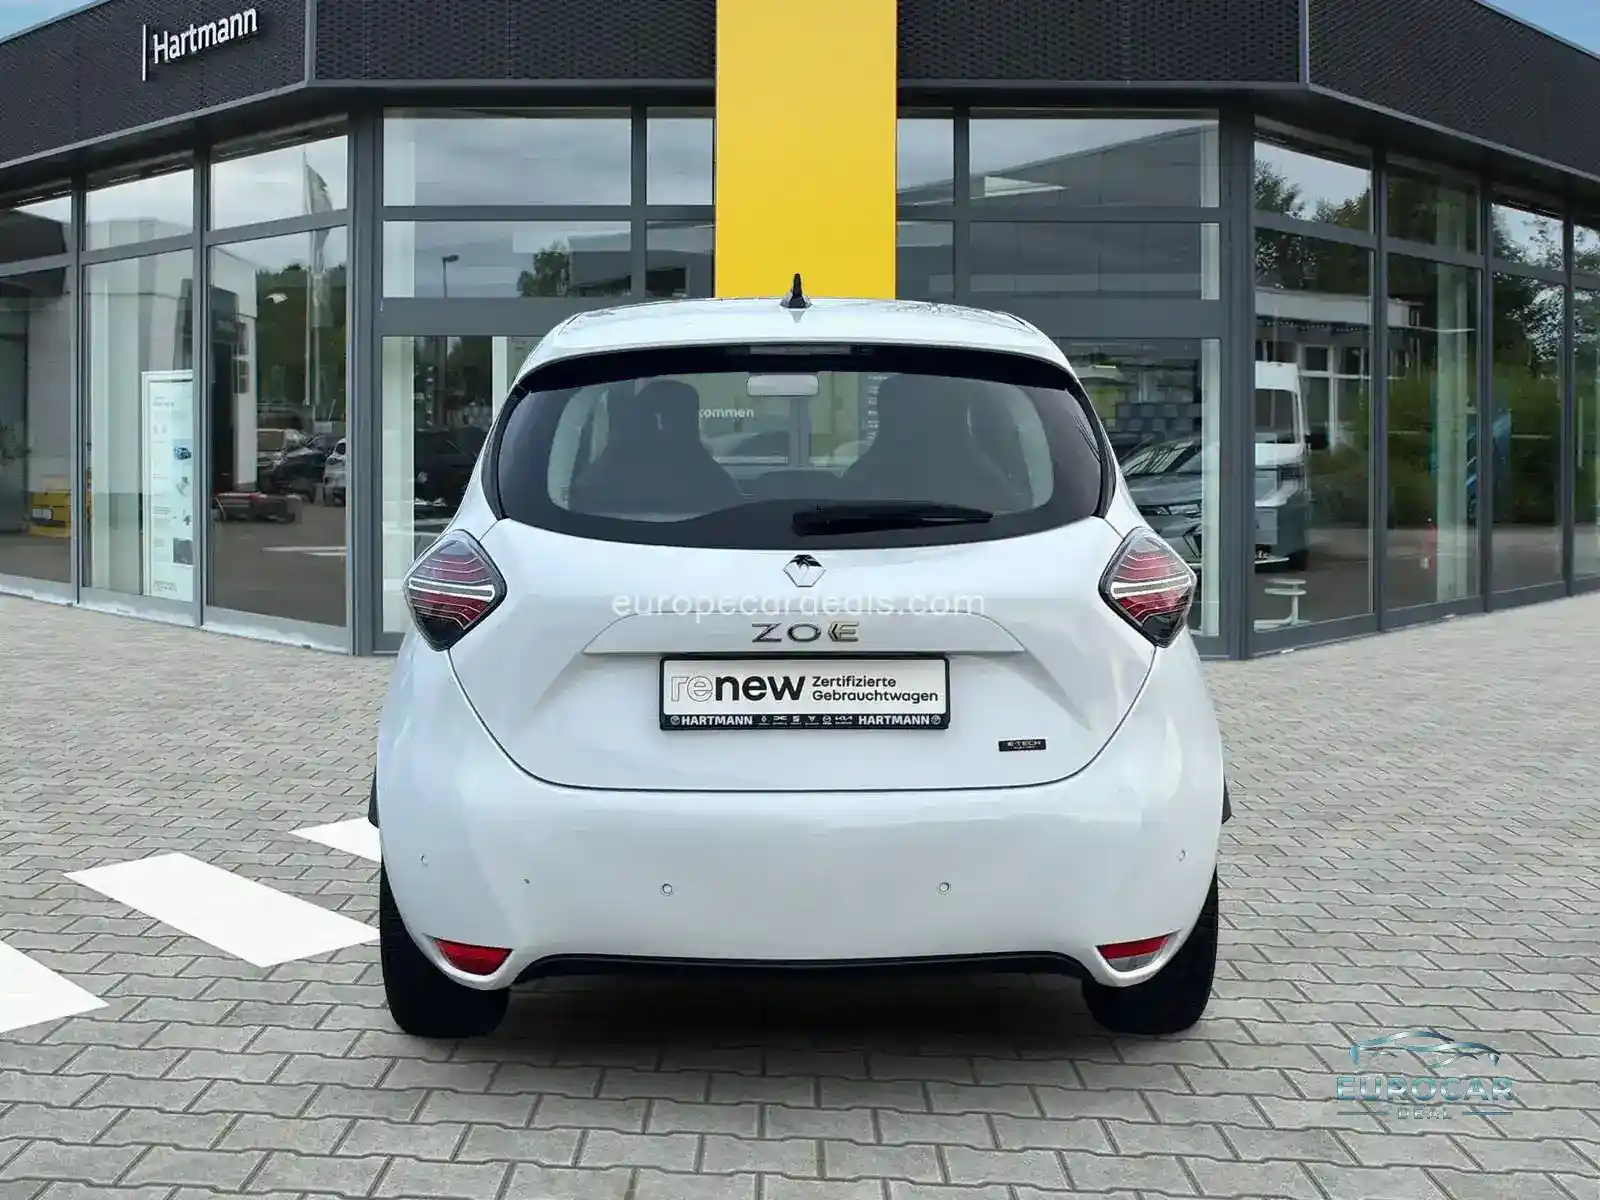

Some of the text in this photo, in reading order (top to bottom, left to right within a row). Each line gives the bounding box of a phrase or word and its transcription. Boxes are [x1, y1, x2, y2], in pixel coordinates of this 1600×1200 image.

[153, 8, 257, 64] Hartmann
[752, 622, 859, 642] ZOE
[671, 675, 806, 702] renew
[812, 675, 897, 687] Zertifizierte
[812, 689, 939, 704] Gebrauchtwagen
[681, 715, 753, 726] HARTMANN
[858, 715, 930, 725] HARTMANN
